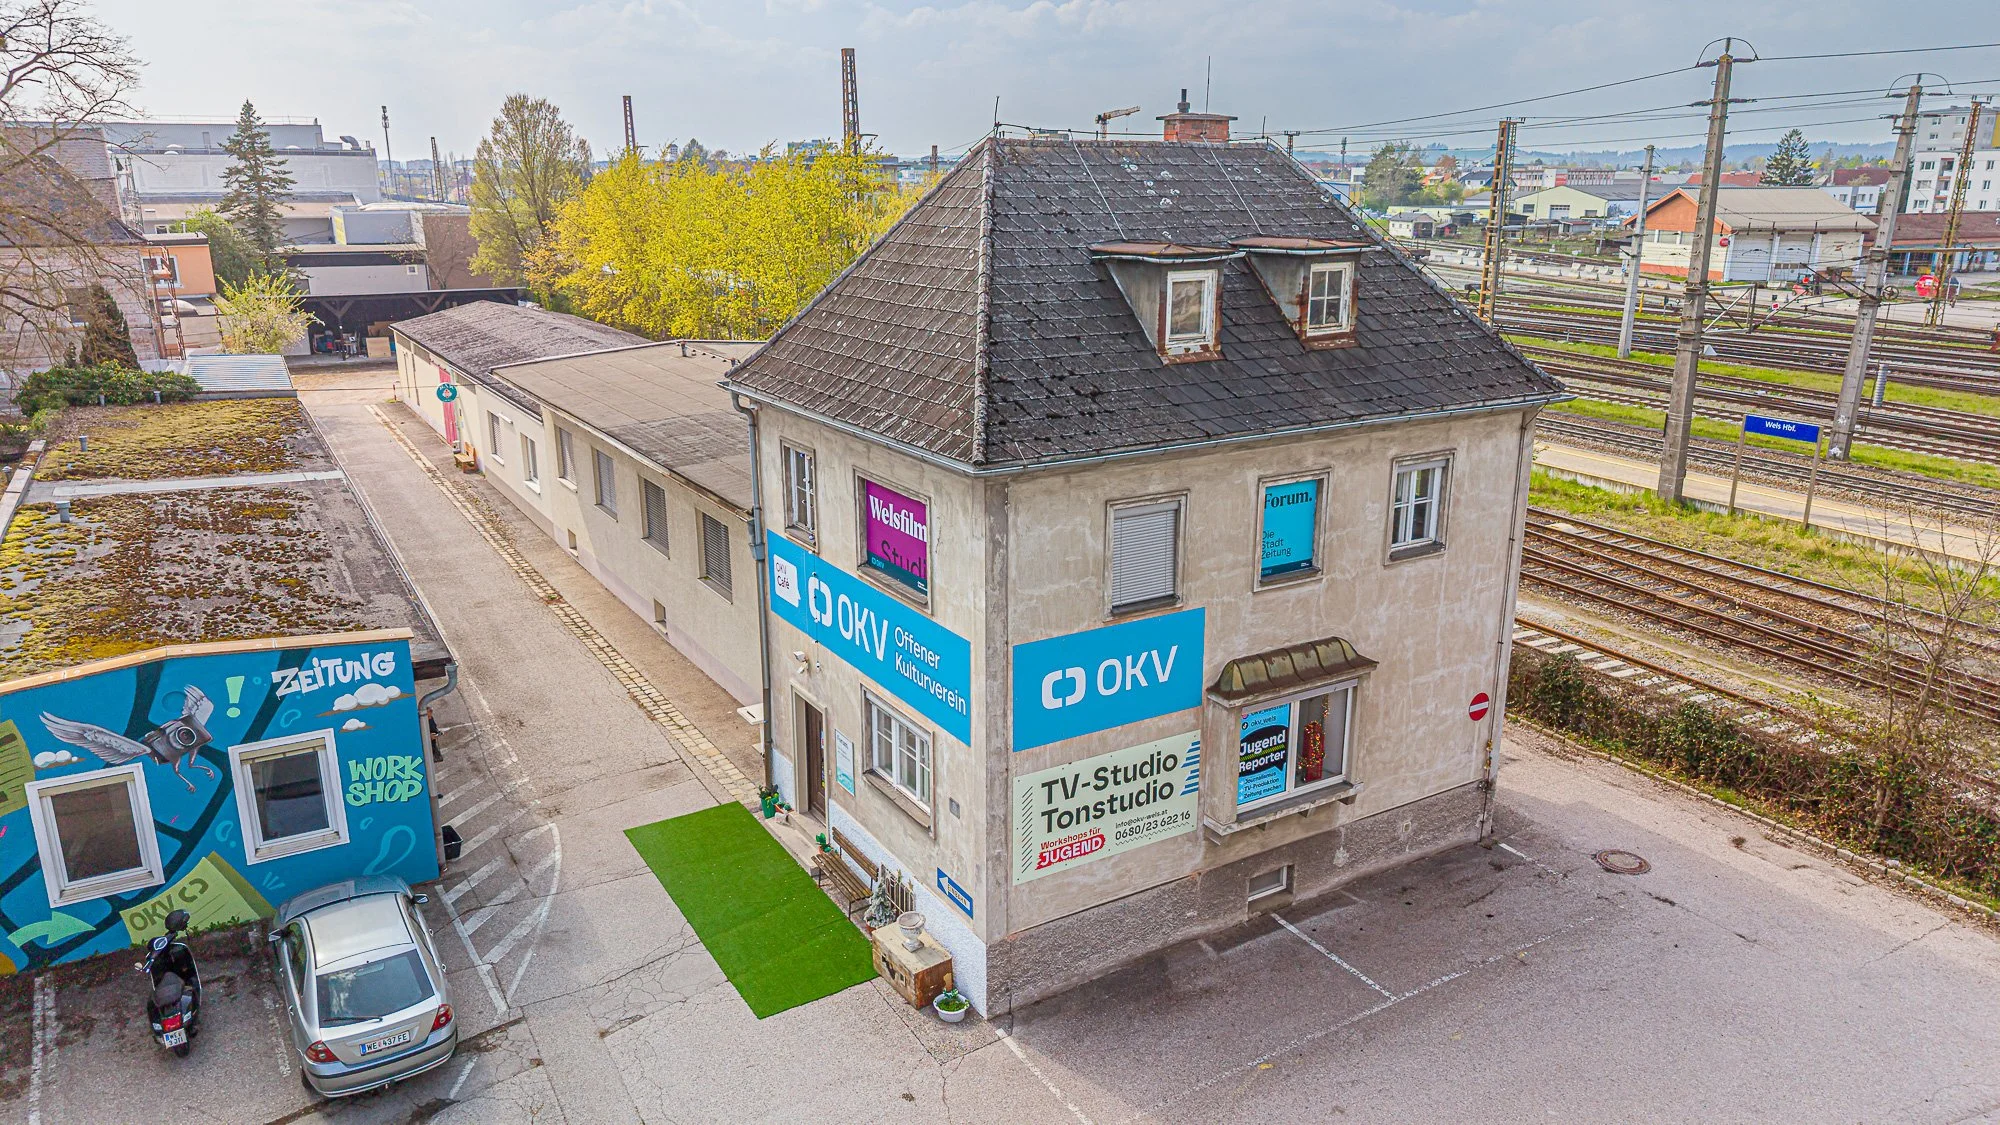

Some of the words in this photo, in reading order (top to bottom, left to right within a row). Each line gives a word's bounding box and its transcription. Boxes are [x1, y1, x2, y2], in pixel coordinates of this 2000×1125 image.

[1765, 421, 1781, 430] Wels
[1782, 423, 1797, 432] Hbf.
[1264, 491, 1312, 509] Forum.
[869, 494, 927, 543] Welsfilm
[1262, 530, 1275, 539] Die
[1262, 538, 1284, 550] Stadt
[1261, 547, 1292, 560] Zeitung
[837, 594, 889, 662] OKV
[894, 626, 941, 670] Offener
[895, 652, 967, 716] Kulturverein
[1096, 644, 1179, 696] OKV
[1240, 730, 1286, 756] Jugend
[347, 755, 424, 782] WORK
[1239, 750, 1286, 772] Reporter
[1041, 750, 1179, 805] TV-Studio
[345, 779, 424, 807] SHOP
[1040, 778, 1175, 834] Tonstudio
[1040, 832, 1088, 851] Workshops
[1088, 826, 1101, 838] für
[1115, 819, 1158, 841] 0680/23
[1160, 813, 1179, 827] 622
[1180, 810, 1191, 821] 16
[1040, 836, 1103, 867] JUGEND
[129, 894, 175, 931] OKV
[366, 1042, 378, 1051] WE
